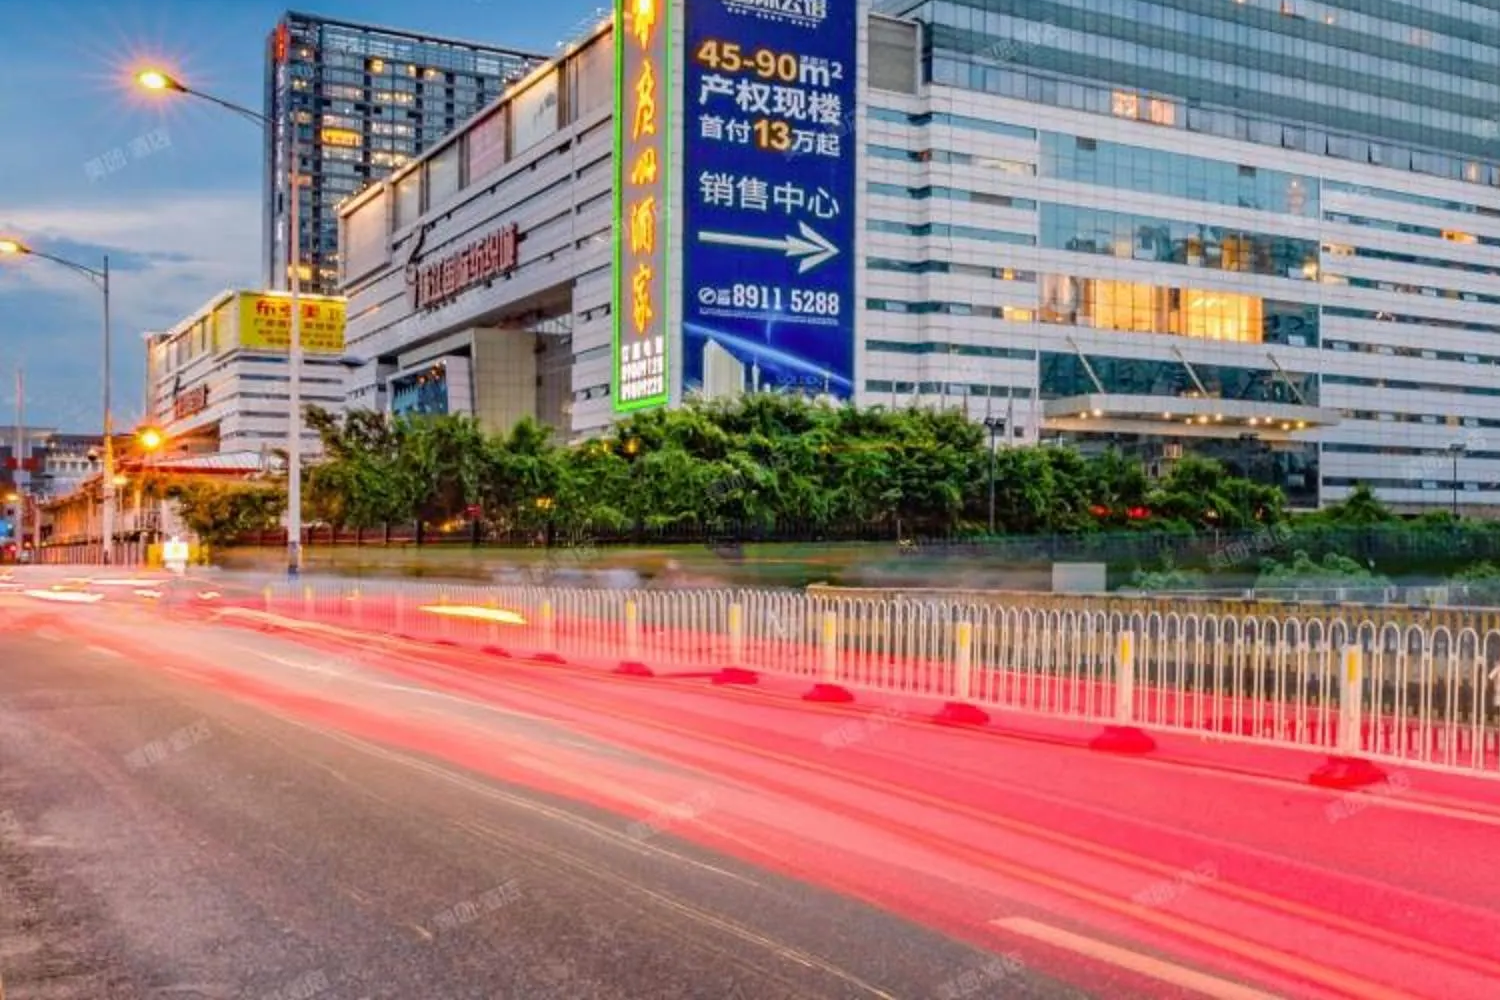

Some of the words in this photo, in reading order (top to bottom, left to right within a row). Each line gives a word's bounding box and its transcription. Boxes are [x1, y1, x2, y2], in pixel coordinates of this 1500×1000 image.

[699, 74, 841, 126] 产权现楼
[699, 113, 841, 157] 首付13万起
[699, 171, 840, 219] 销售中心
[733, 284, 781, 311] 8911
[790, 289, 839, 316] 5288
